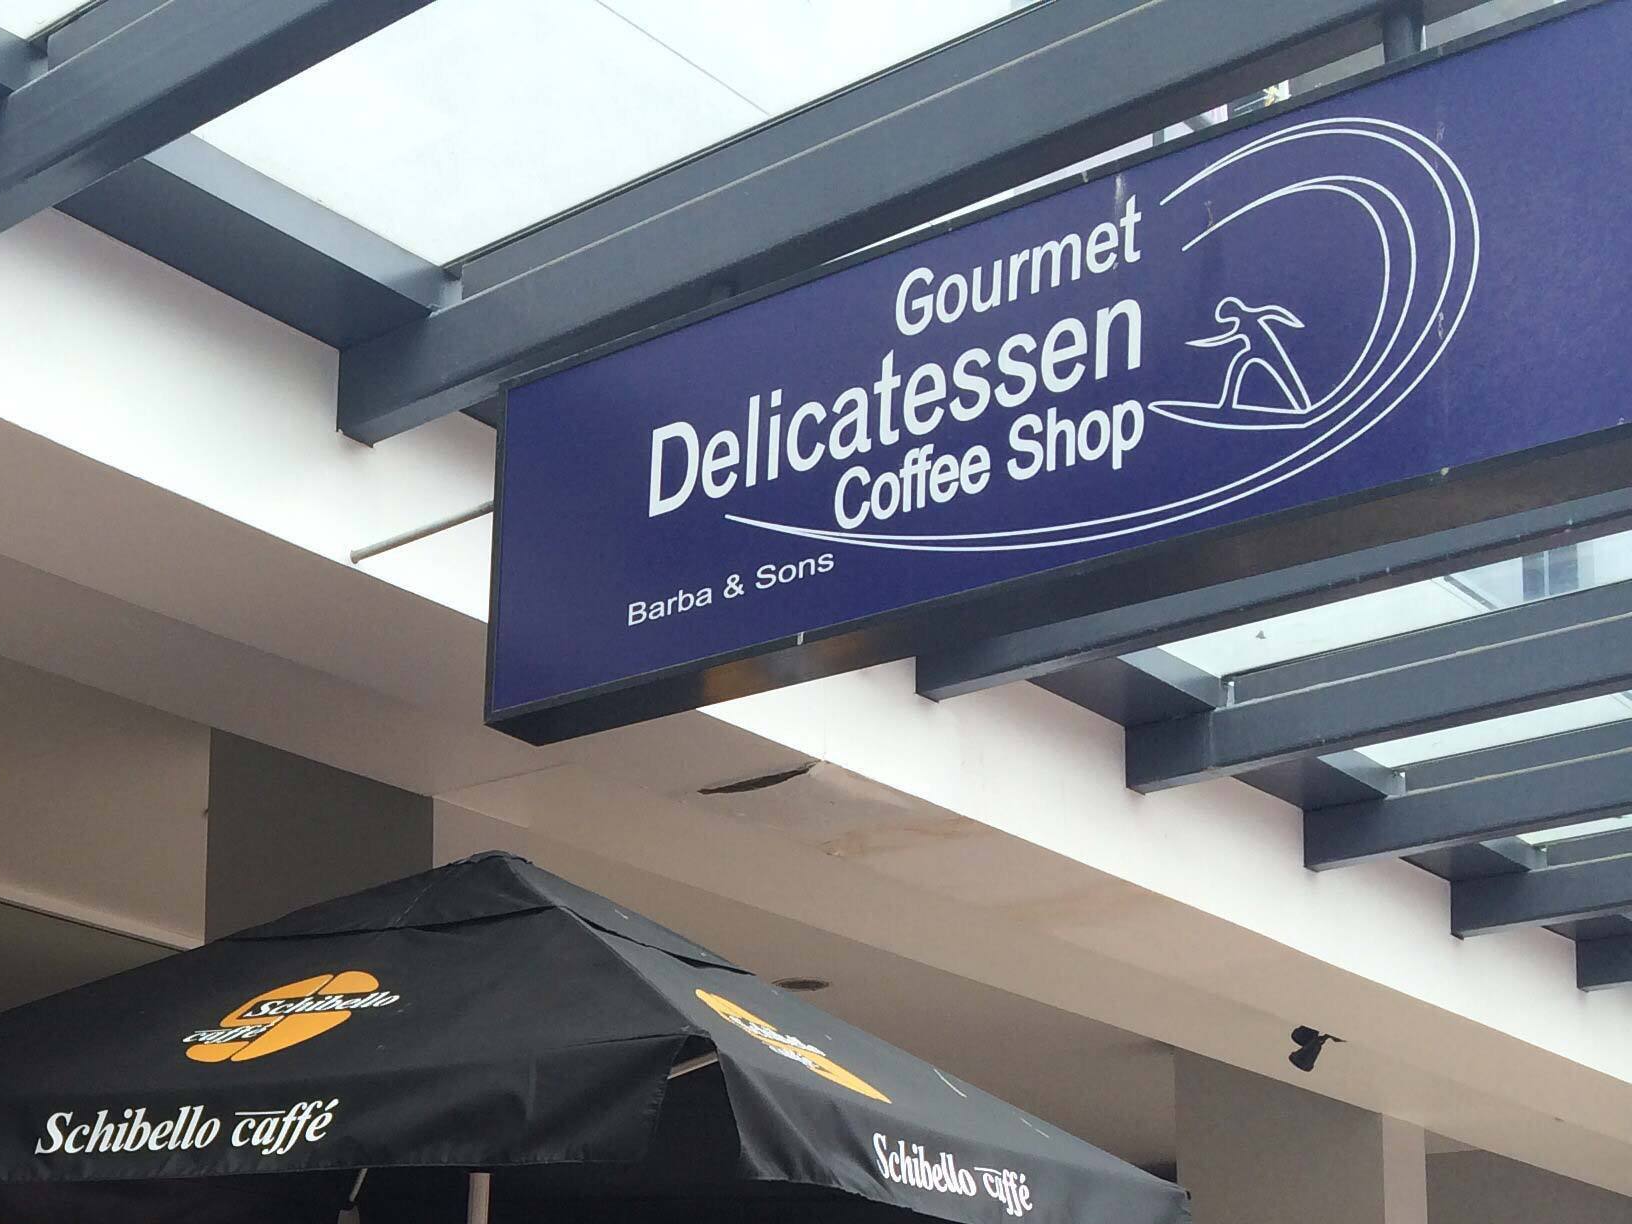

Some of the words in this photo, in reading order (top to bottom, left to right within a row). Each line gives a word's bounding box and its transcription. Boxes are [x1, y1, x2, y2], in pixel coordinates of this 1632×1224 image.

[895, 194, 1142, 336] Gourmet
[648, 299, 1142, 518] Delicatessen
[834, 444, 991, 530] Coffee
[1007, 399, 1145, 481] Shop
[627, 585, 712, 626] Barba
[723, 575, 745, 599] &
[755, 552, 835, 590] Sons
[182, 1021, 279, 1044] caffé
[243, 991, 400, 1018] Schibello
[35, 1105, 221, 1156] Schibello
[231, 1098, 340, 1156] caffé
[873, 1132, 977, 1196] Schibello
[975, 1165, 1033, 1217] caffé
